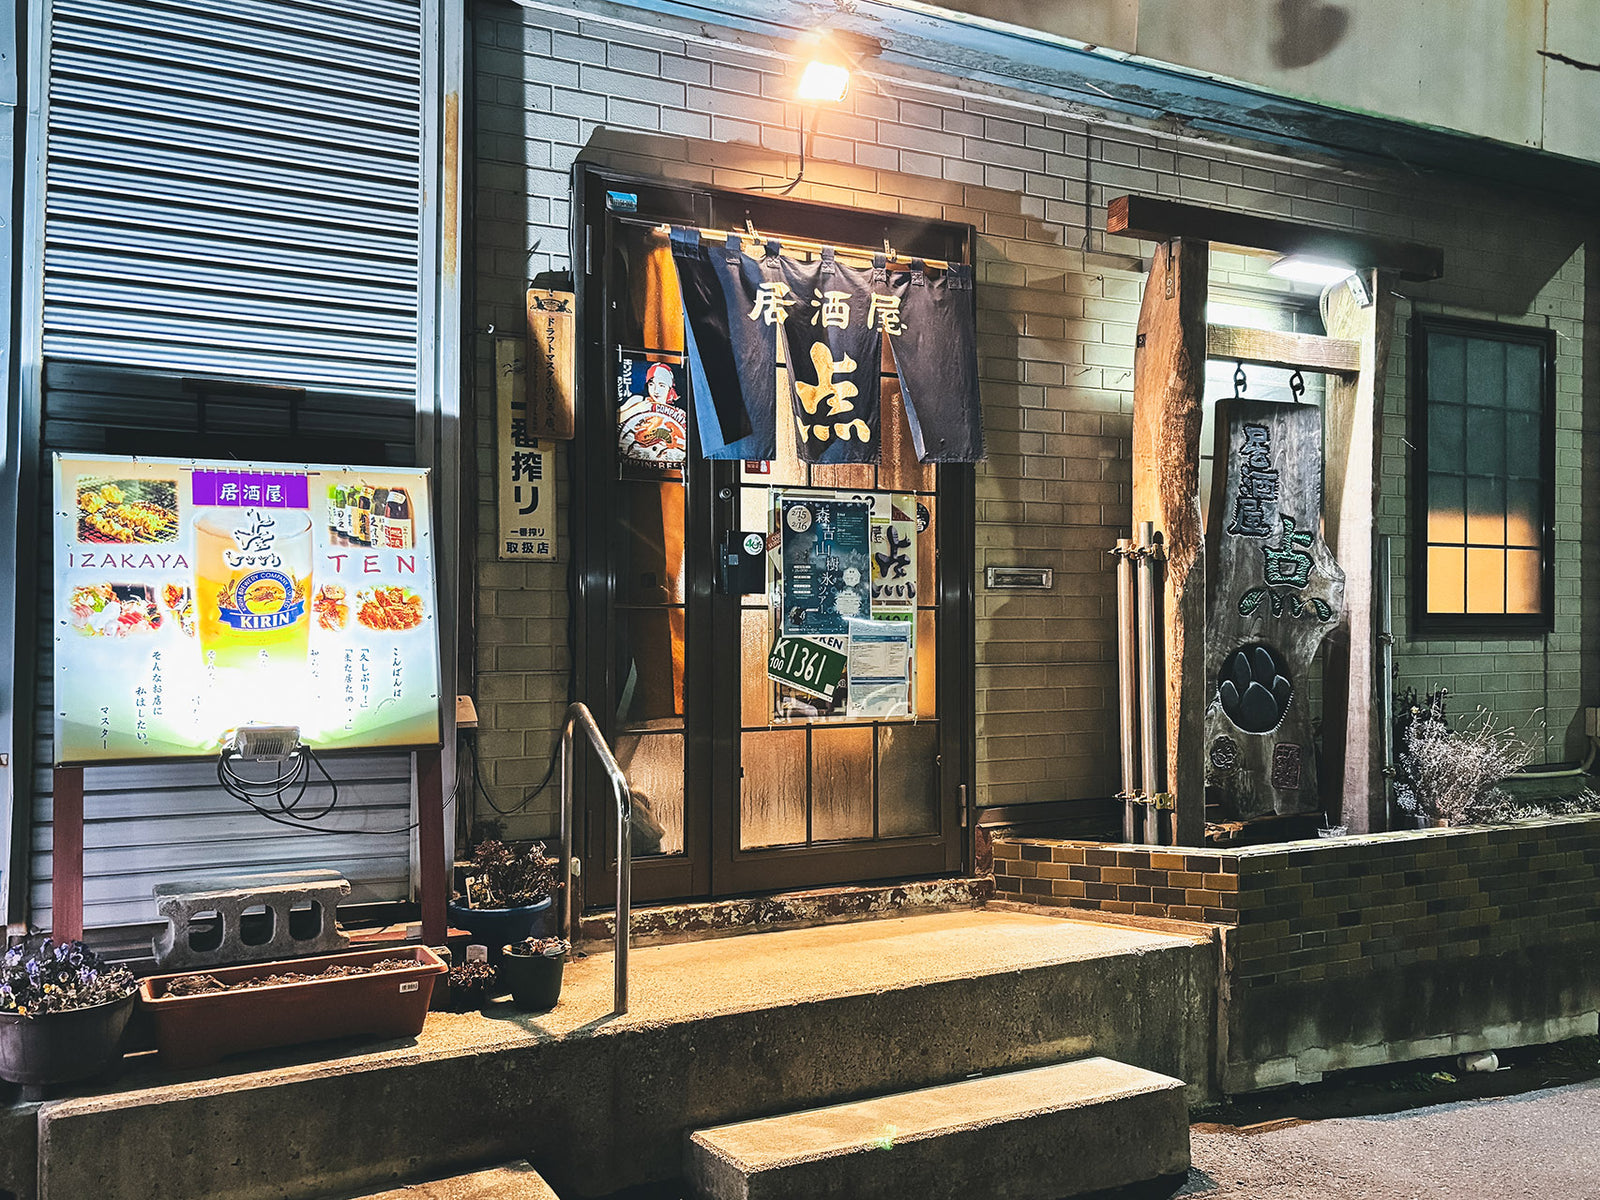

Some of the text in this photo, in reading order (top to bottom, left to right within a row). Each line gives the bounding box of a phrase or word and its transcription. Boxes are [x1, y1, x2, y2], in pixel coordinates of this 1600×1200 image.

[748, 281, 907, 336] 居酒屋
[795, 341, 870, 443] 点
[219, 482, 285, 503] 居酒屋
[69, 553, 415, 573] IZAKAYA TEN
[506, 542, 550, 554] 取扱店
[815, 506, 840, 614] 森吉山樹氷ツアー
[240, 612, 290, 628] KIRIN
[769, 656, 785, 671] 100
[773, 636, 791, 659] K
[785, 643, 827, 685] 1361
[152, 651, 163, 715] そんなお店に
[392, 647, 403, 697] こんばんは
[100, 706, 110, 749] マスター
